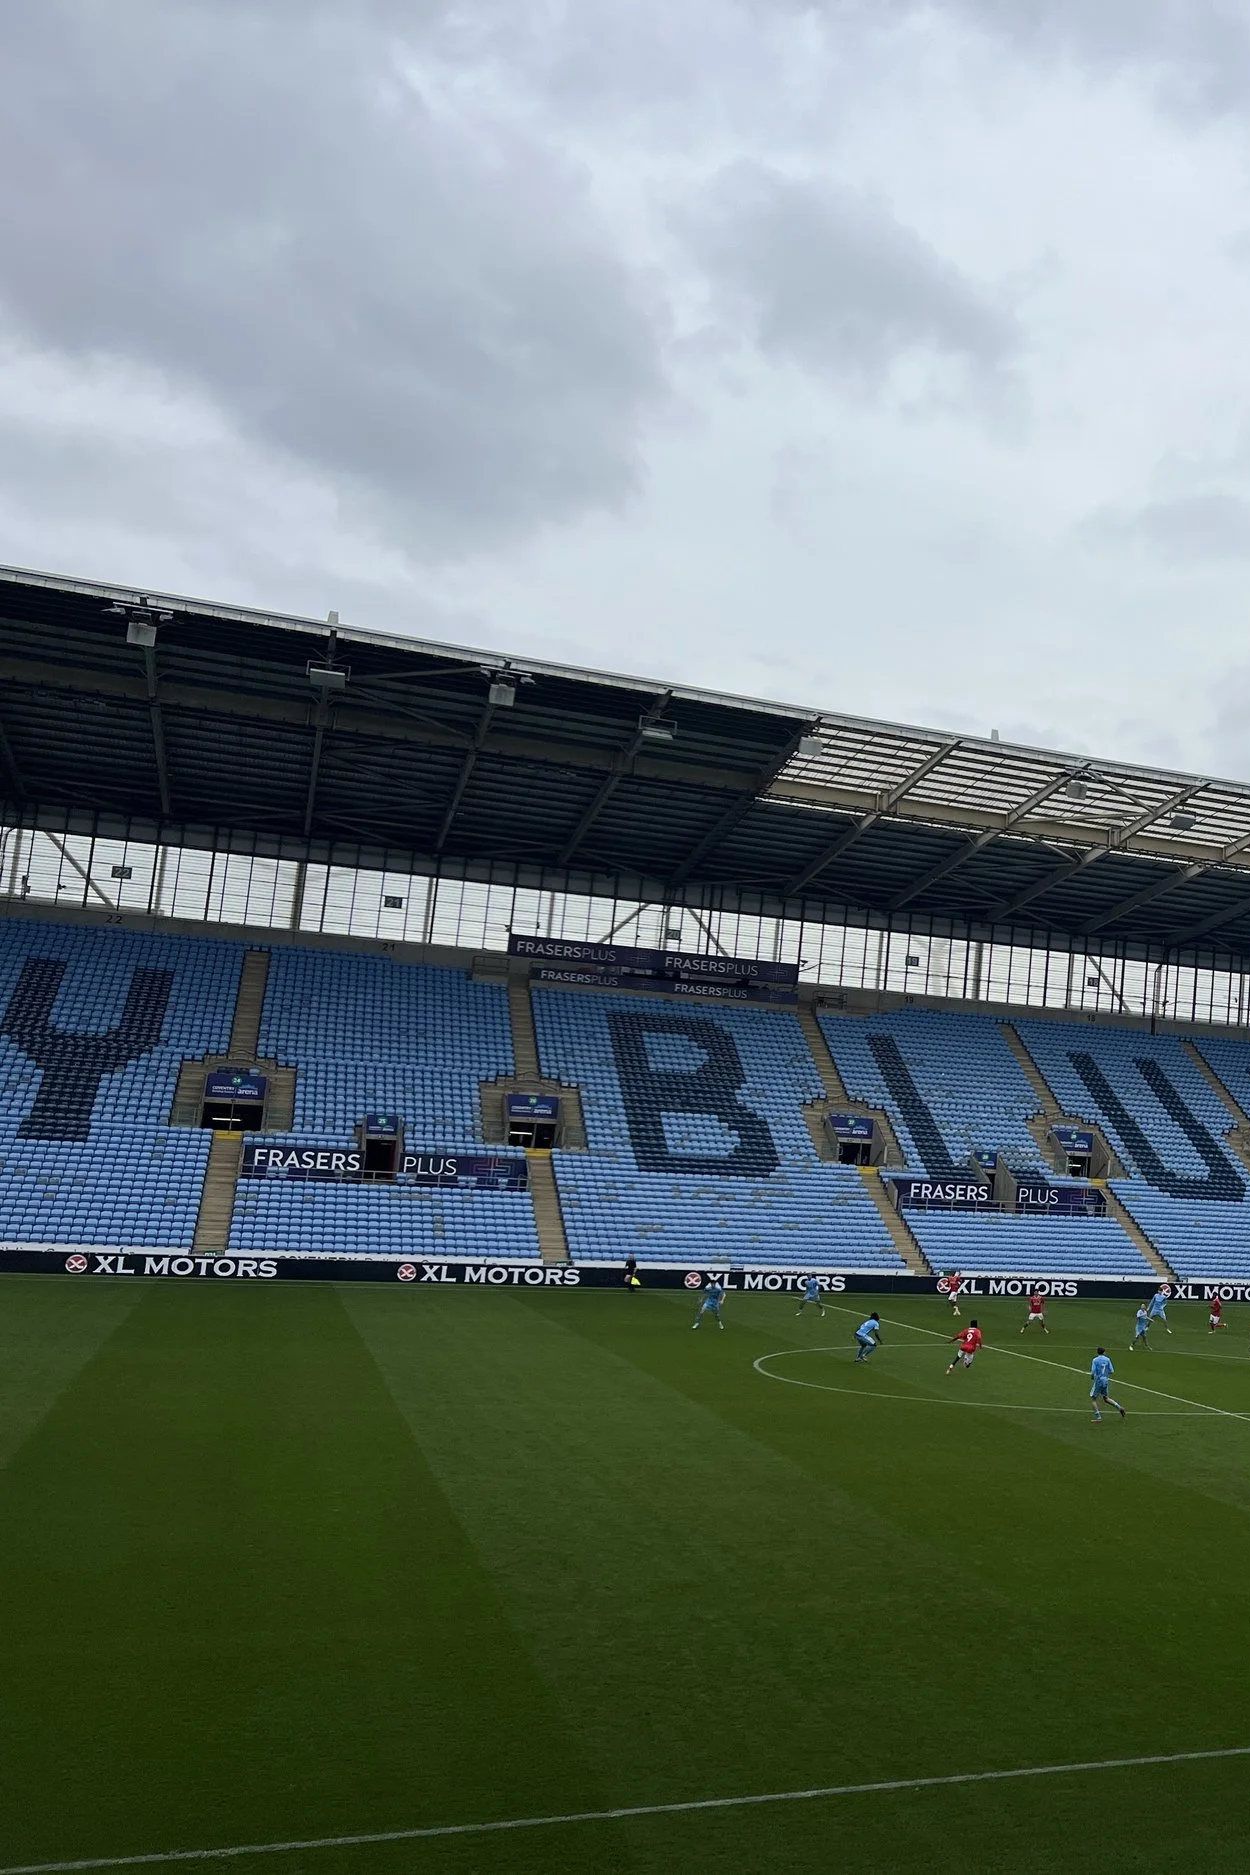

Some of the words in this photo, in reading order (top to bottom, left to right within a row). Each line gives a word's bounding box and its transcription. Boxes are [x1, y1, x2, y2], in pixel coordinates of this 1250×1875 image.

[115, 867, 130, 877] 22
[386, 898, 400, 907] 21
[104, 914, 123, 925] 22
[666, 929, 680, 939] 20
[382, 942, 396, 952] 21
[253, 1148, 362, 1172] FRASERS
[403, 1156, 457, 1176] PLUS
[910, 1182, 989, 1202] FRASERS
[1018, 1187, 1060, 1206] PLUS
[93, 1255, 135, 1275] XL
[143, 1257, 278, 1278] MOTORS
[420, 1264, 456, 1283] XL
[463, 1266, 580, 1285] MOTORS
[956, 1279, 983, 1295] XL
[988, 1279, 1078, 1297] MOTORS
[1173, 1284, 1199, 1300] XL
[966, 1332, 973, 1342] 9
[1101, 1364, 1106, 1374] 7
